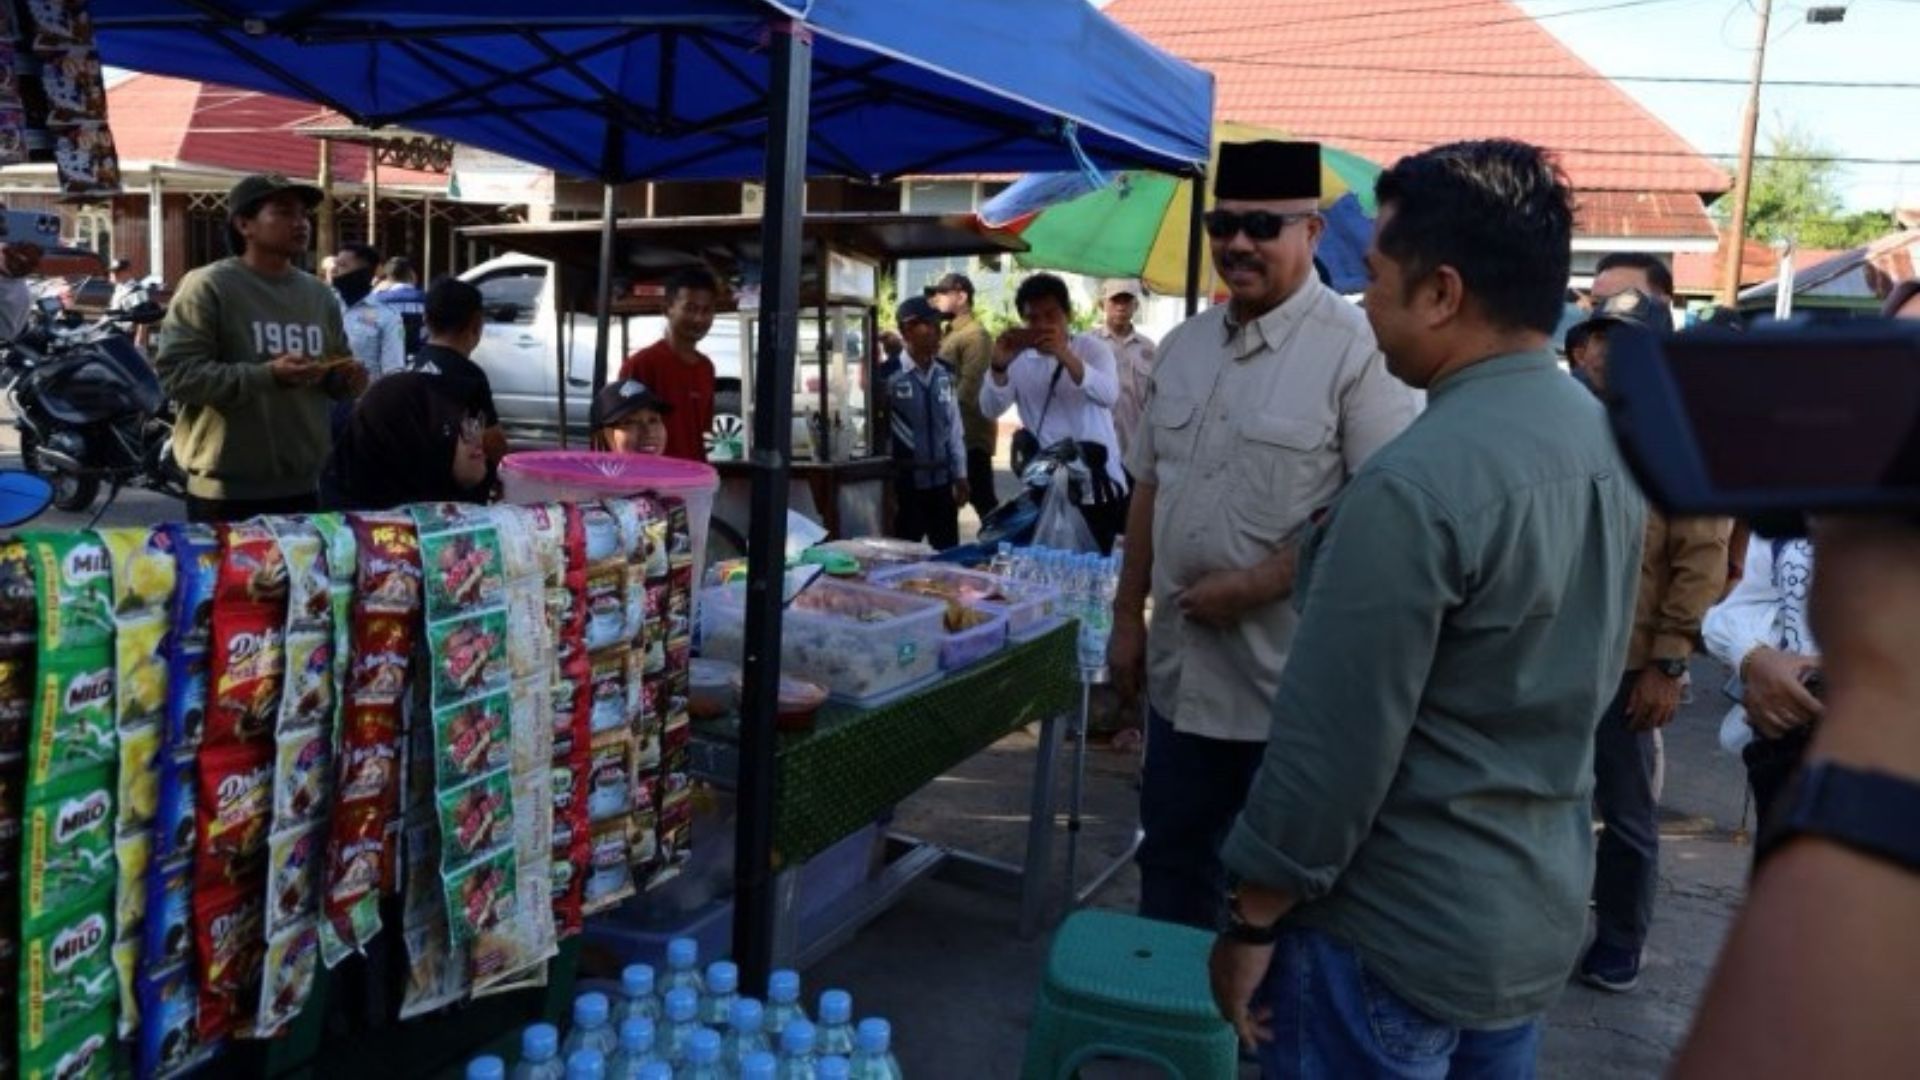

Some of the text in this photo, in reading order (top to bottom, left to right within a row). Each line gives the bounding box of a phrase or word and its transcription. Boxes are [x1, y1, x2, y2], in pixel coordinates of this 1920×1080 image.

[252, 321, 323, 356] 1960
[69, 679, 112, 708] MILO
[60, 803, 106, 836] MILO
[55, 927, 101, 967] MILO
